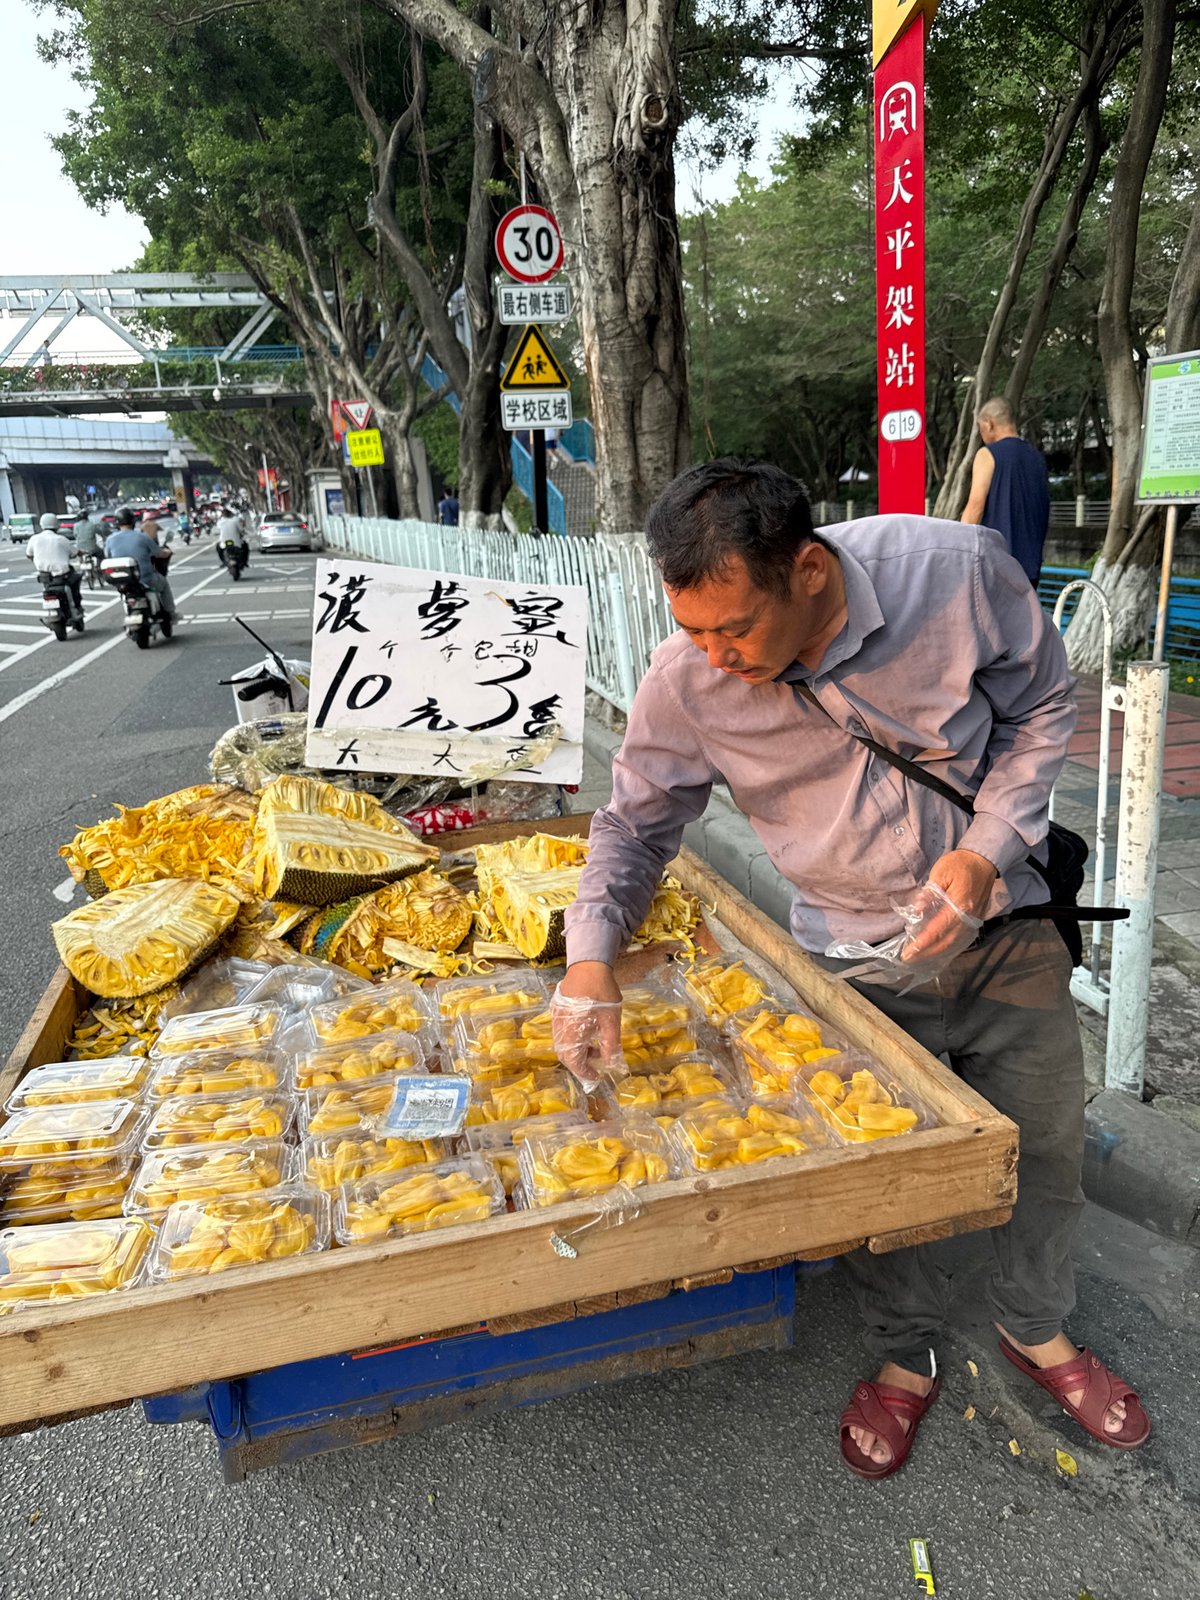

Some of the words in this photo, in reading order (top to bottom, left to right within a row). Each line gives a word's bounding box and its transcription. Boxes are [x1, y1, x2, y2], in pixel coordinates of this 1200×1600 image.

[513, 226, 554, 262] 30
[882, 157, 916, 389] 天平架站
[503, 292, 568, 317] 最右侧车道
[506, 399, 568, 423] 学校区域
